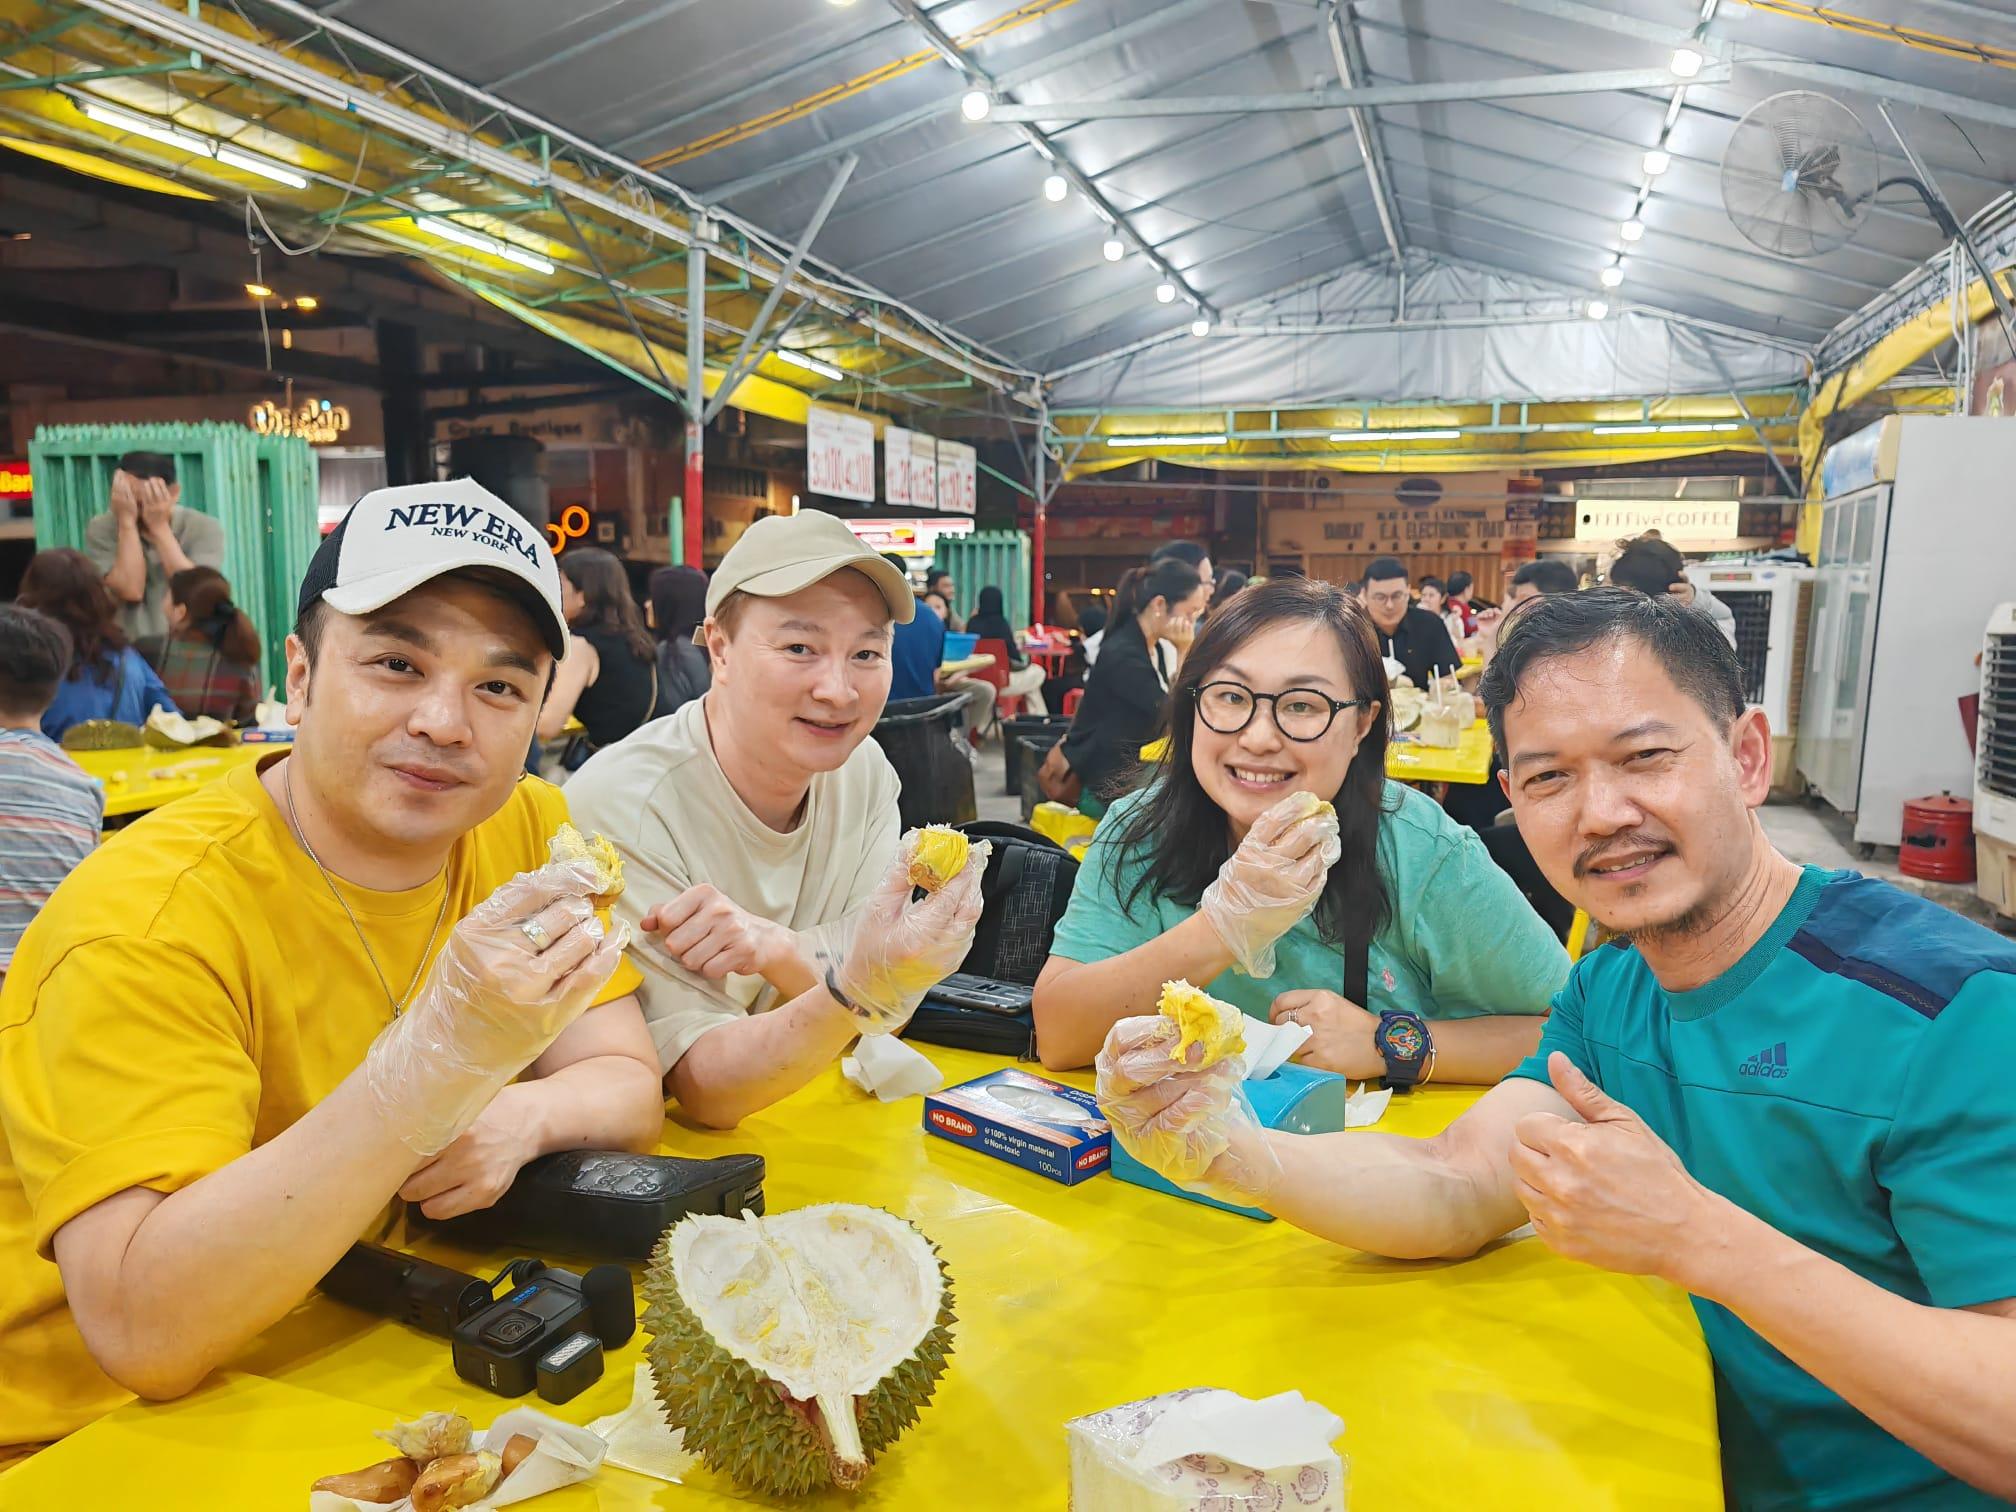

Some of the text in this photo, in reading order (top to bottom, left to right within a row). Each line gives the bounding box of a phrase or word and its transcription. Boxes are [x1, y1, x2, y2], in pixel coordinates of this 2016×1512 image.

[384, 503, 541, 569] NEW ERA
[431, 526, 509, 554] NEW YORK
[1738, 1062, 1790, 1079] adidas
[932, 1112, 974, 1134] NO BRAND
[989, 1138, 1021, 1157] Non-toxic
[990, 1128, 1008, 1141] 100%
[1008, 1135, 1027, 1149] virgin
[1028, 1143, 1055, 1159] material
[1078, 1148, 1109, 1168] NO BRAND
